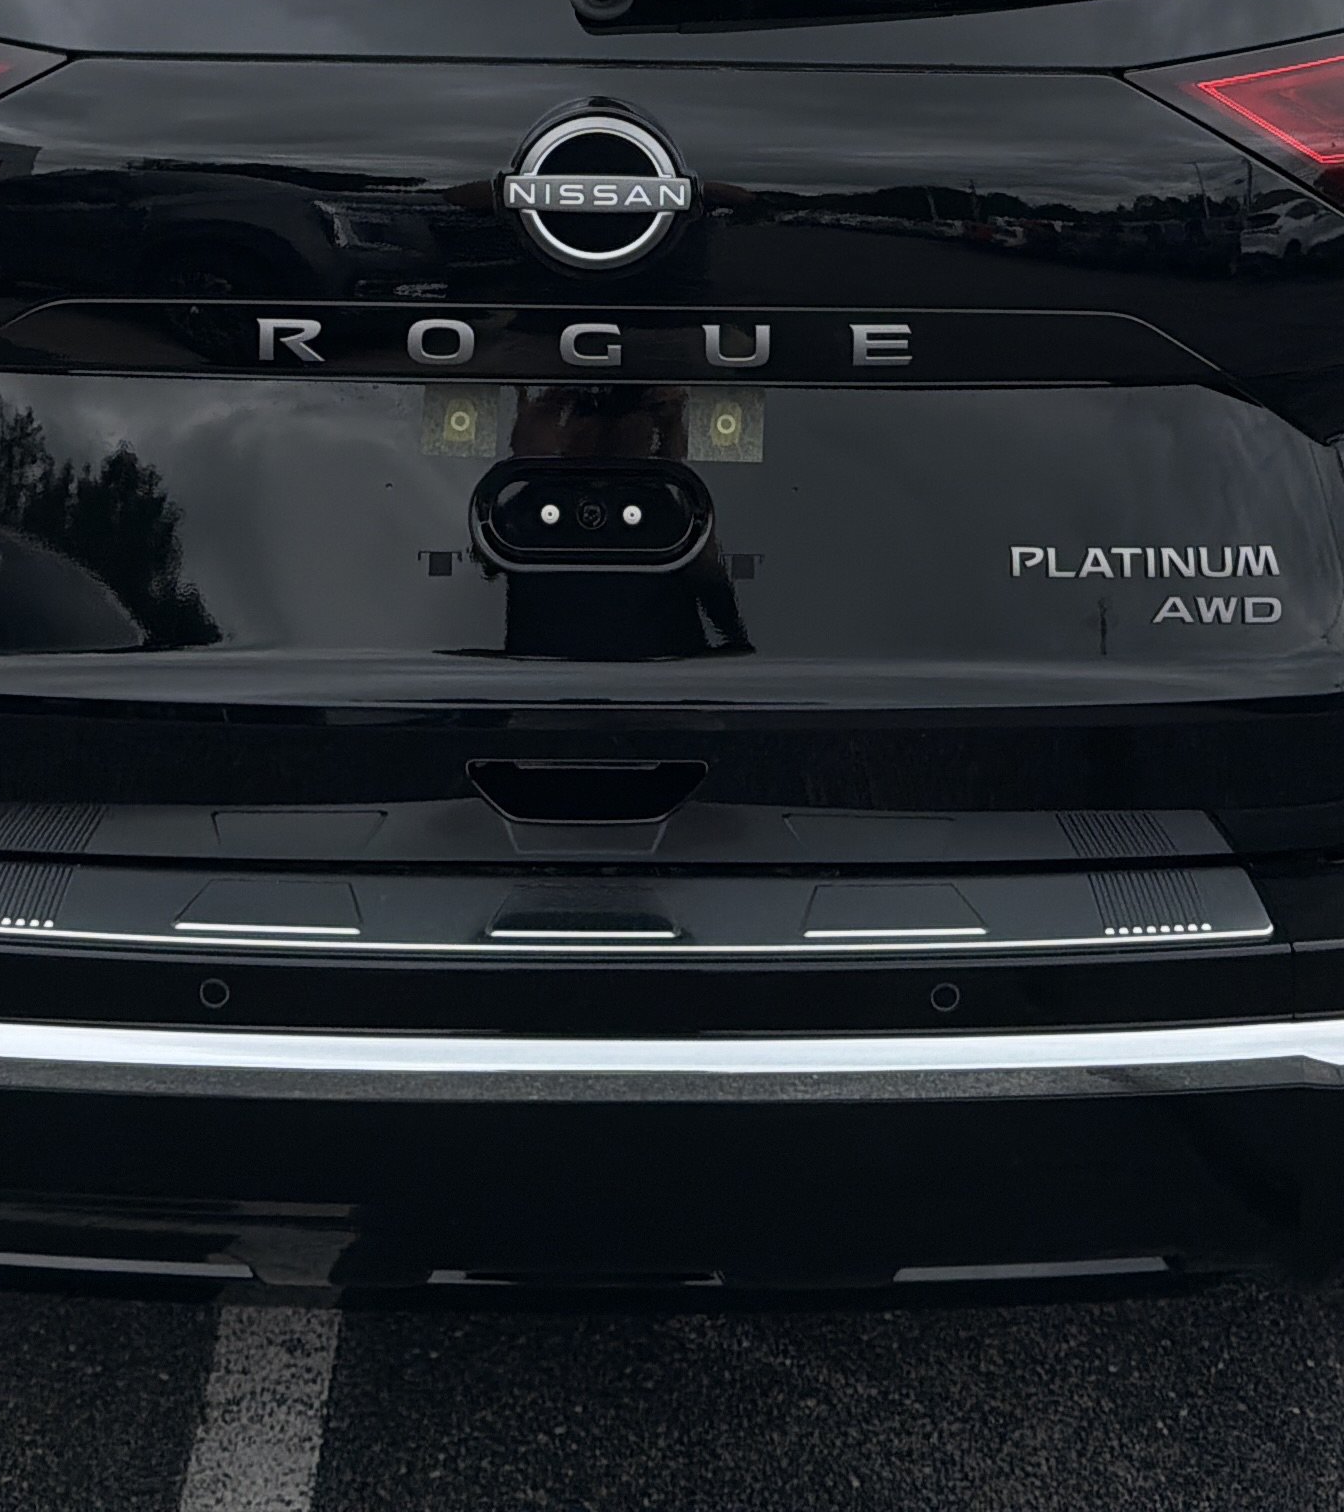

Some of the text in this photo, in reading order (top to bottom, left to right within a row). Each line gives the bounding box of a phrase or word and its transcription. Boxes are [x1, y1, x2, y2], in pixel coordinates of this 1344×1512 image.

[509, 182, 685, 206] NISSAN
[256, 317, 913, 368] ROGUE
[1009, 545, 1281, 578] PLATINUM
[1152, 597, 1282, 624] AWD
